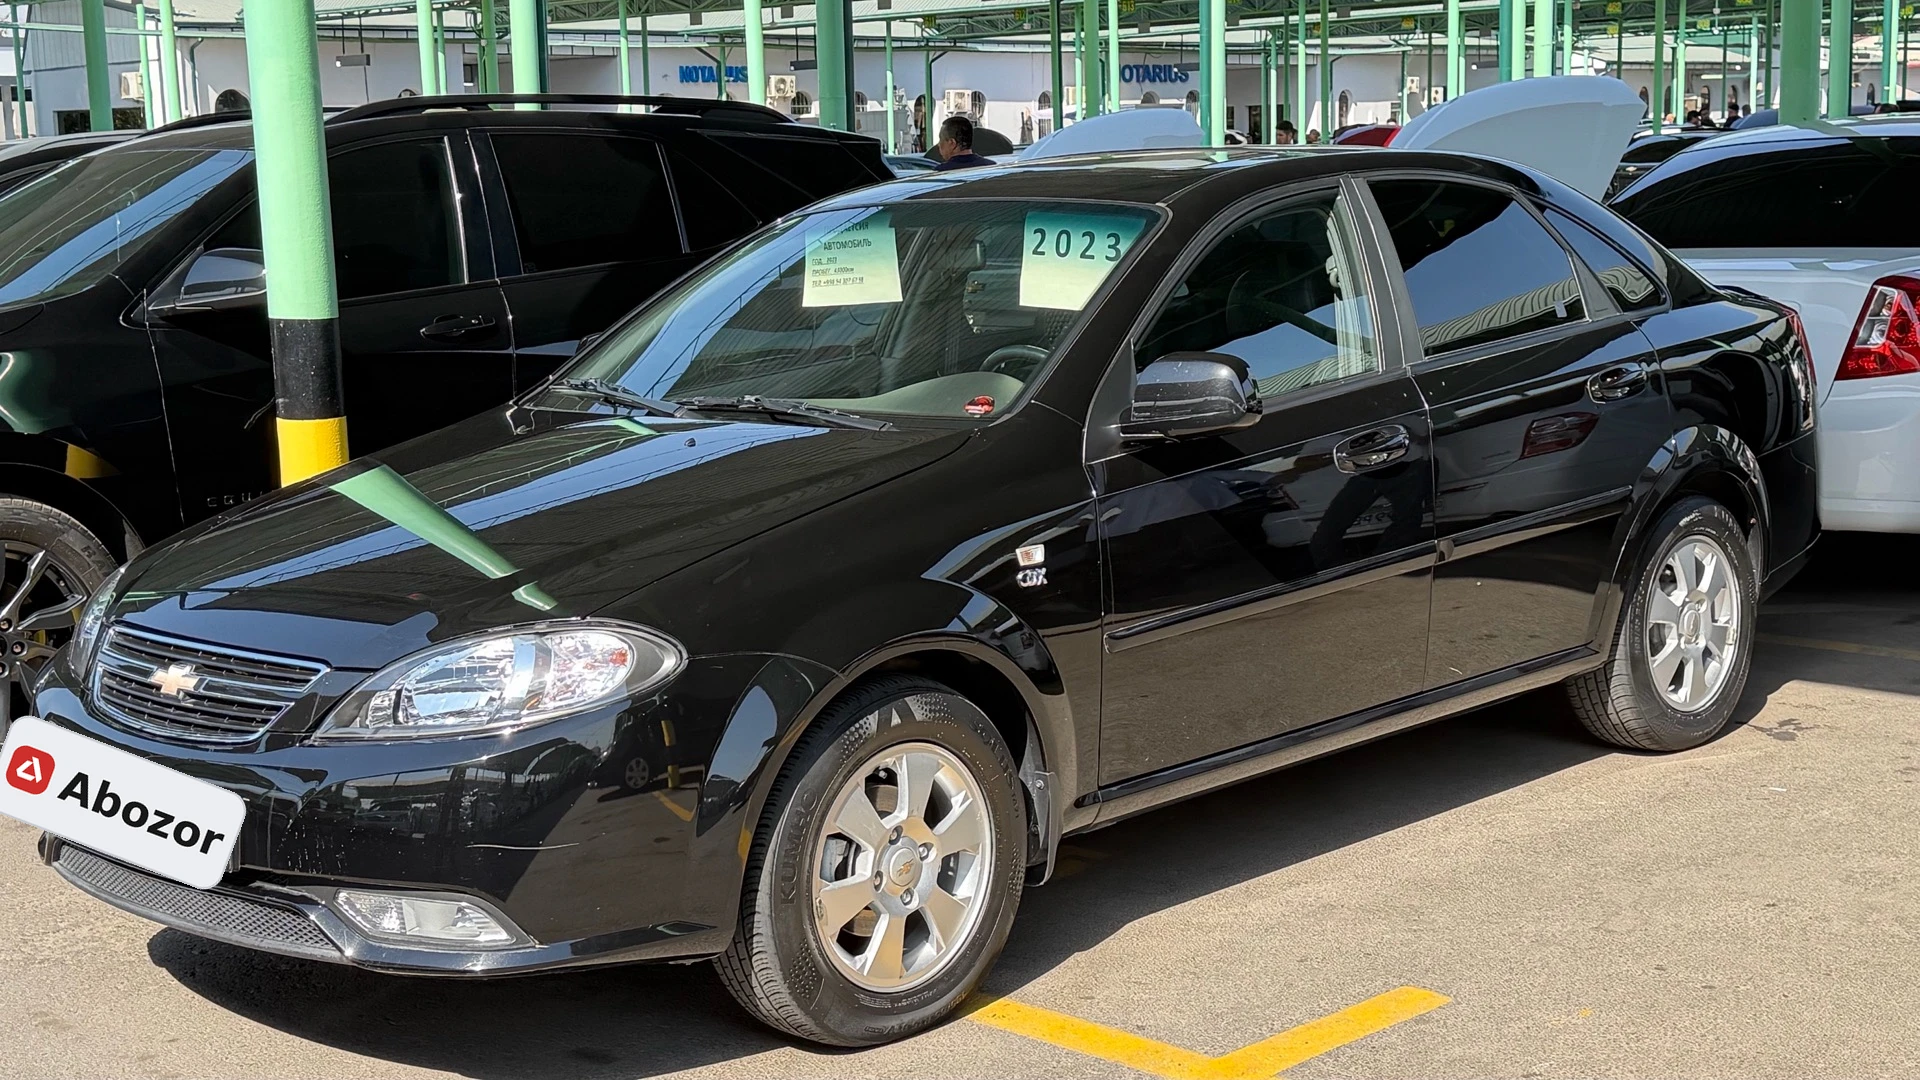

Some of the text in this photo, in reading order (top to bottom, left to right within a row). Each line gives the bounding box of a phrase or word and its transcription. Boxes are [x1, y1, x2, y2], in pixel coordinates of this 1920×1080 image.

[679, 65, 749, 83] NOTAIUS
[1119, 64, 1189, 83] OTARIUS
[823, 239, 872, 251] АВТОМОБИЛЬ
[1031, 228, 1122, 262] 2023
